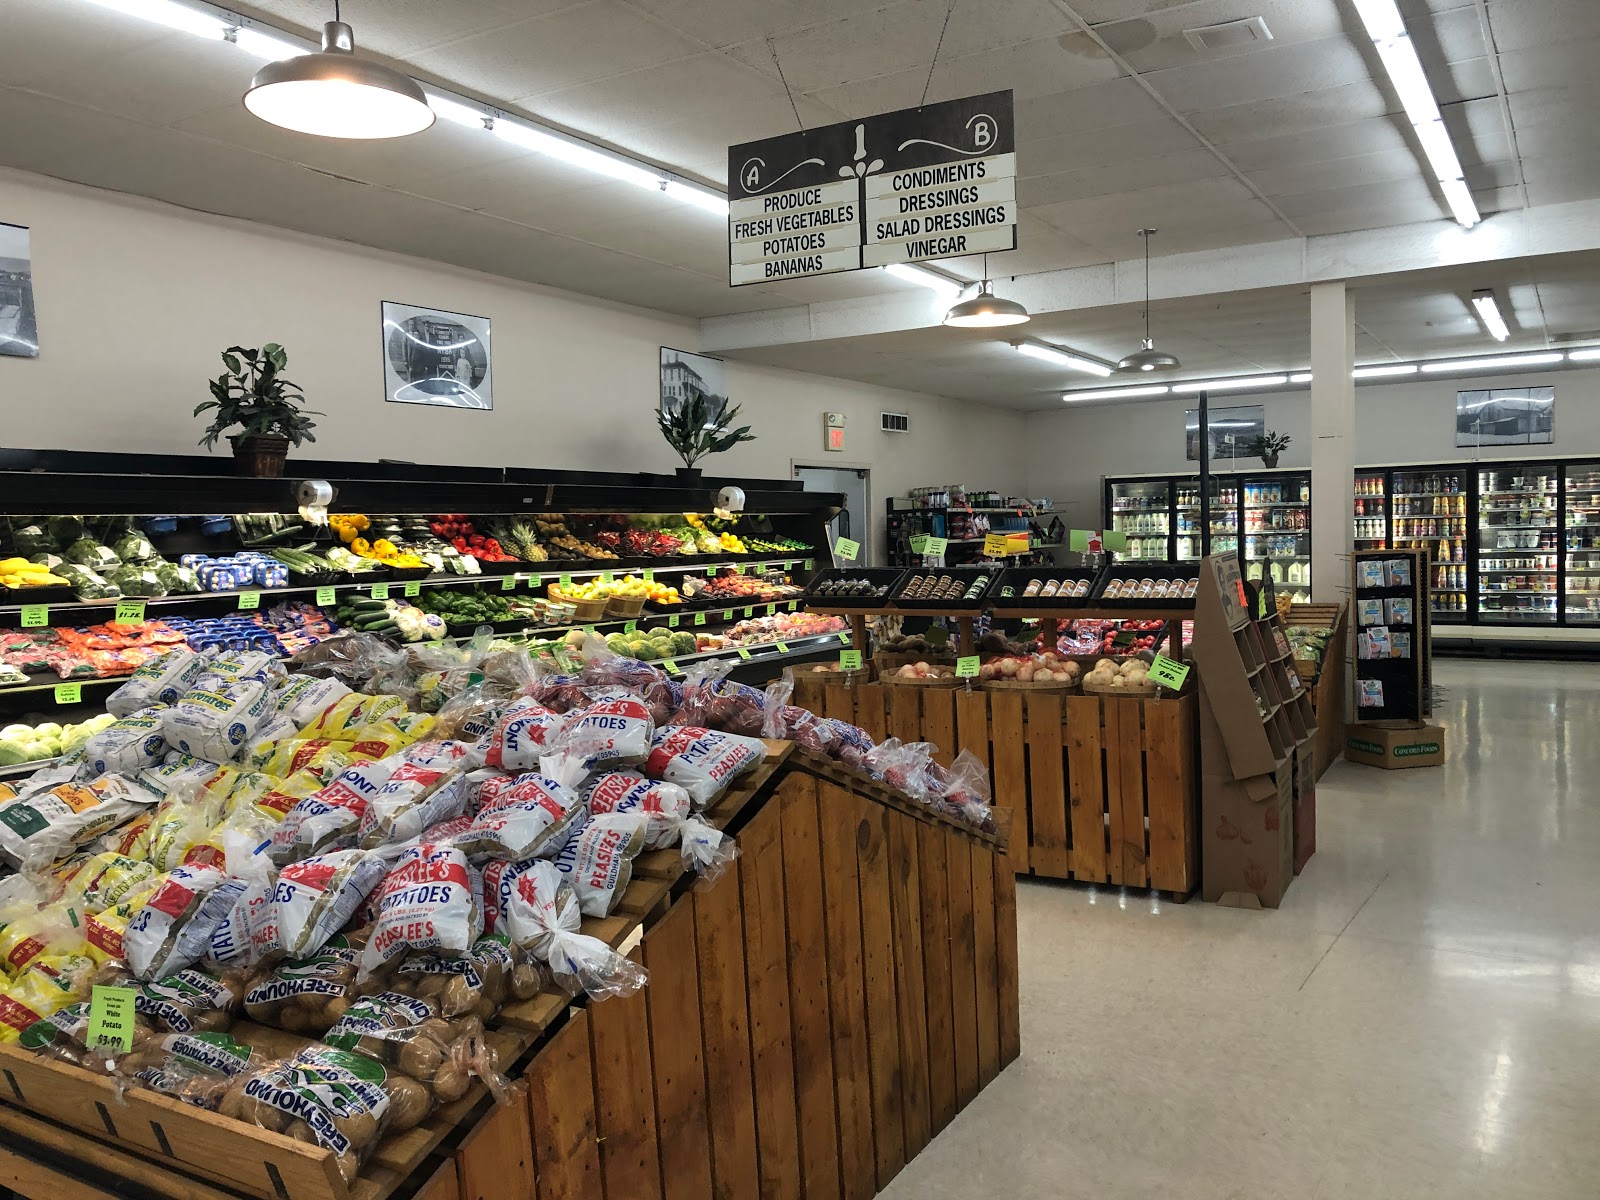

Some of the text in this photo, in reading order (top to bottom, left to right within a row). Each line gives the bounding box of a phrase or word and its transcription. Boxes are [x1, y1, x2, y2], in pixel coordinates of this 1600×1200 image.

[746, 165, 760, 187] A
[892, 161, 986, 192] CONDIMENTS
[764, 188, 822, 213] PRODUCE
[899, 186, 979, 214] DRESSINGS
[735, 206, 854, 240] FRESH VEGETABLES
[876, 206, 1006, 240] SALAD DRESSINGS
[762, 232, 826, 256] POTATOES
[906, 235, 967, 258] VINEGAR
[764, 255, 823, 278] BANANAS
[246, 979, 344, 1003] GREYHOUND
[102, 1020, 122, 1029] Potato
[98, 1034, 122, 1047] $3.99
[171, 1041, 216, 1066] POTATOES
[244, 1078, 348, 1152] GREYHOUND
